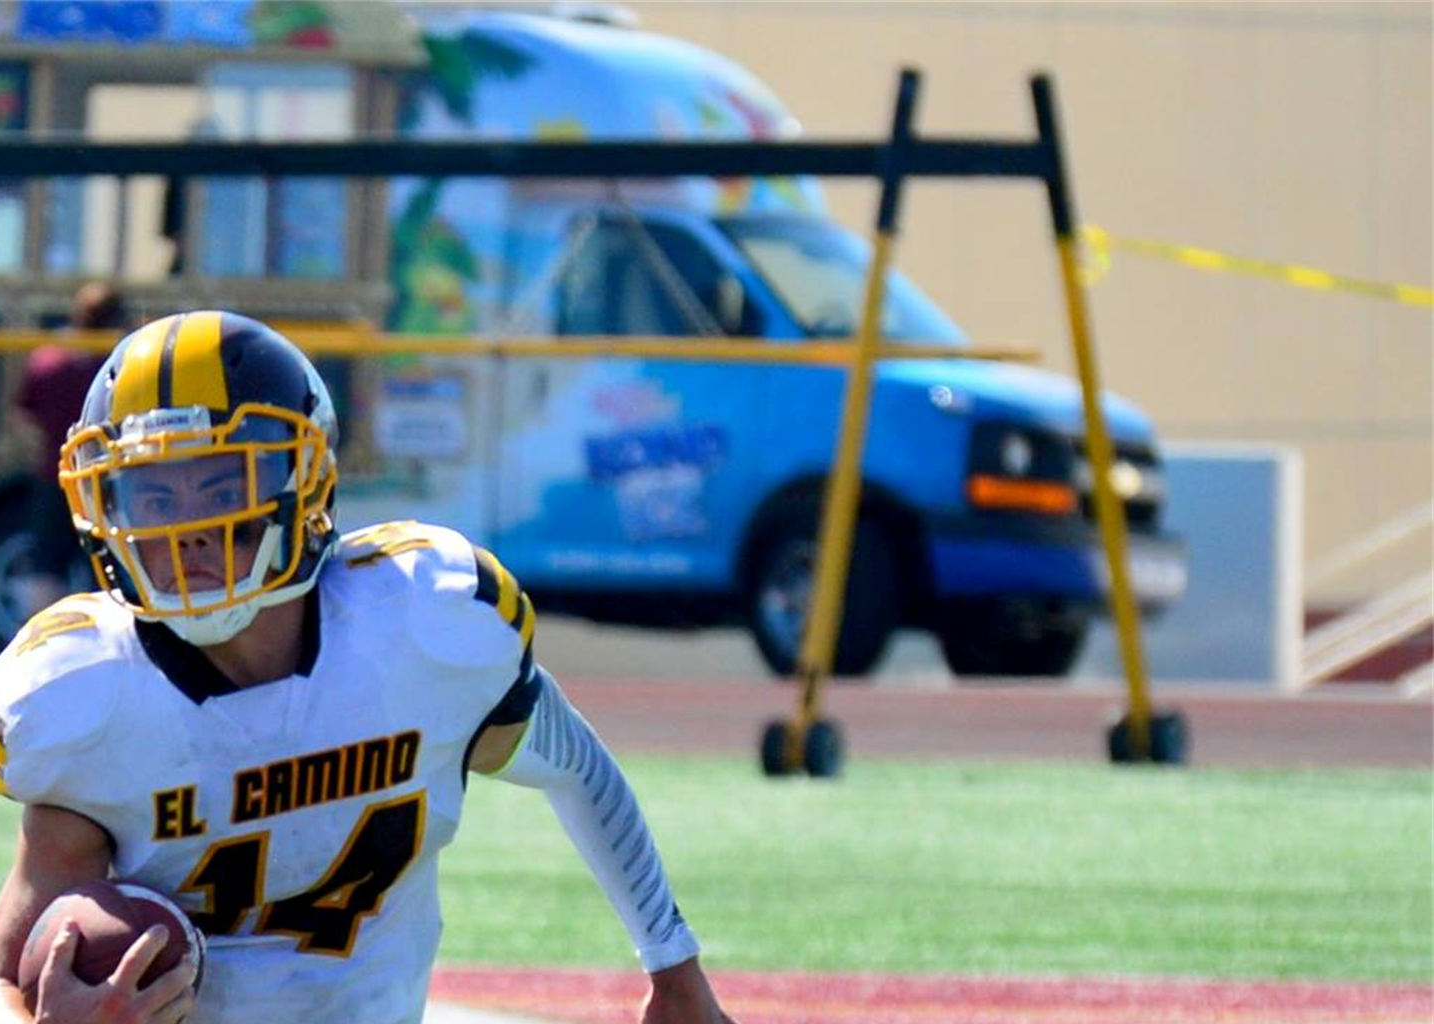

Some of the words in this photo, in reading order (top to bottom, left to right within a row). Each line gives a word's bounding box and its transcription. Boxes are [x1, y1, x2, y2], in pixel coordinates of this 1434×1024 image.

[153, 784, 207, 840] EL
[230, 728, 421, 823] CAMINO
[177, 789, 427, 959] 14
